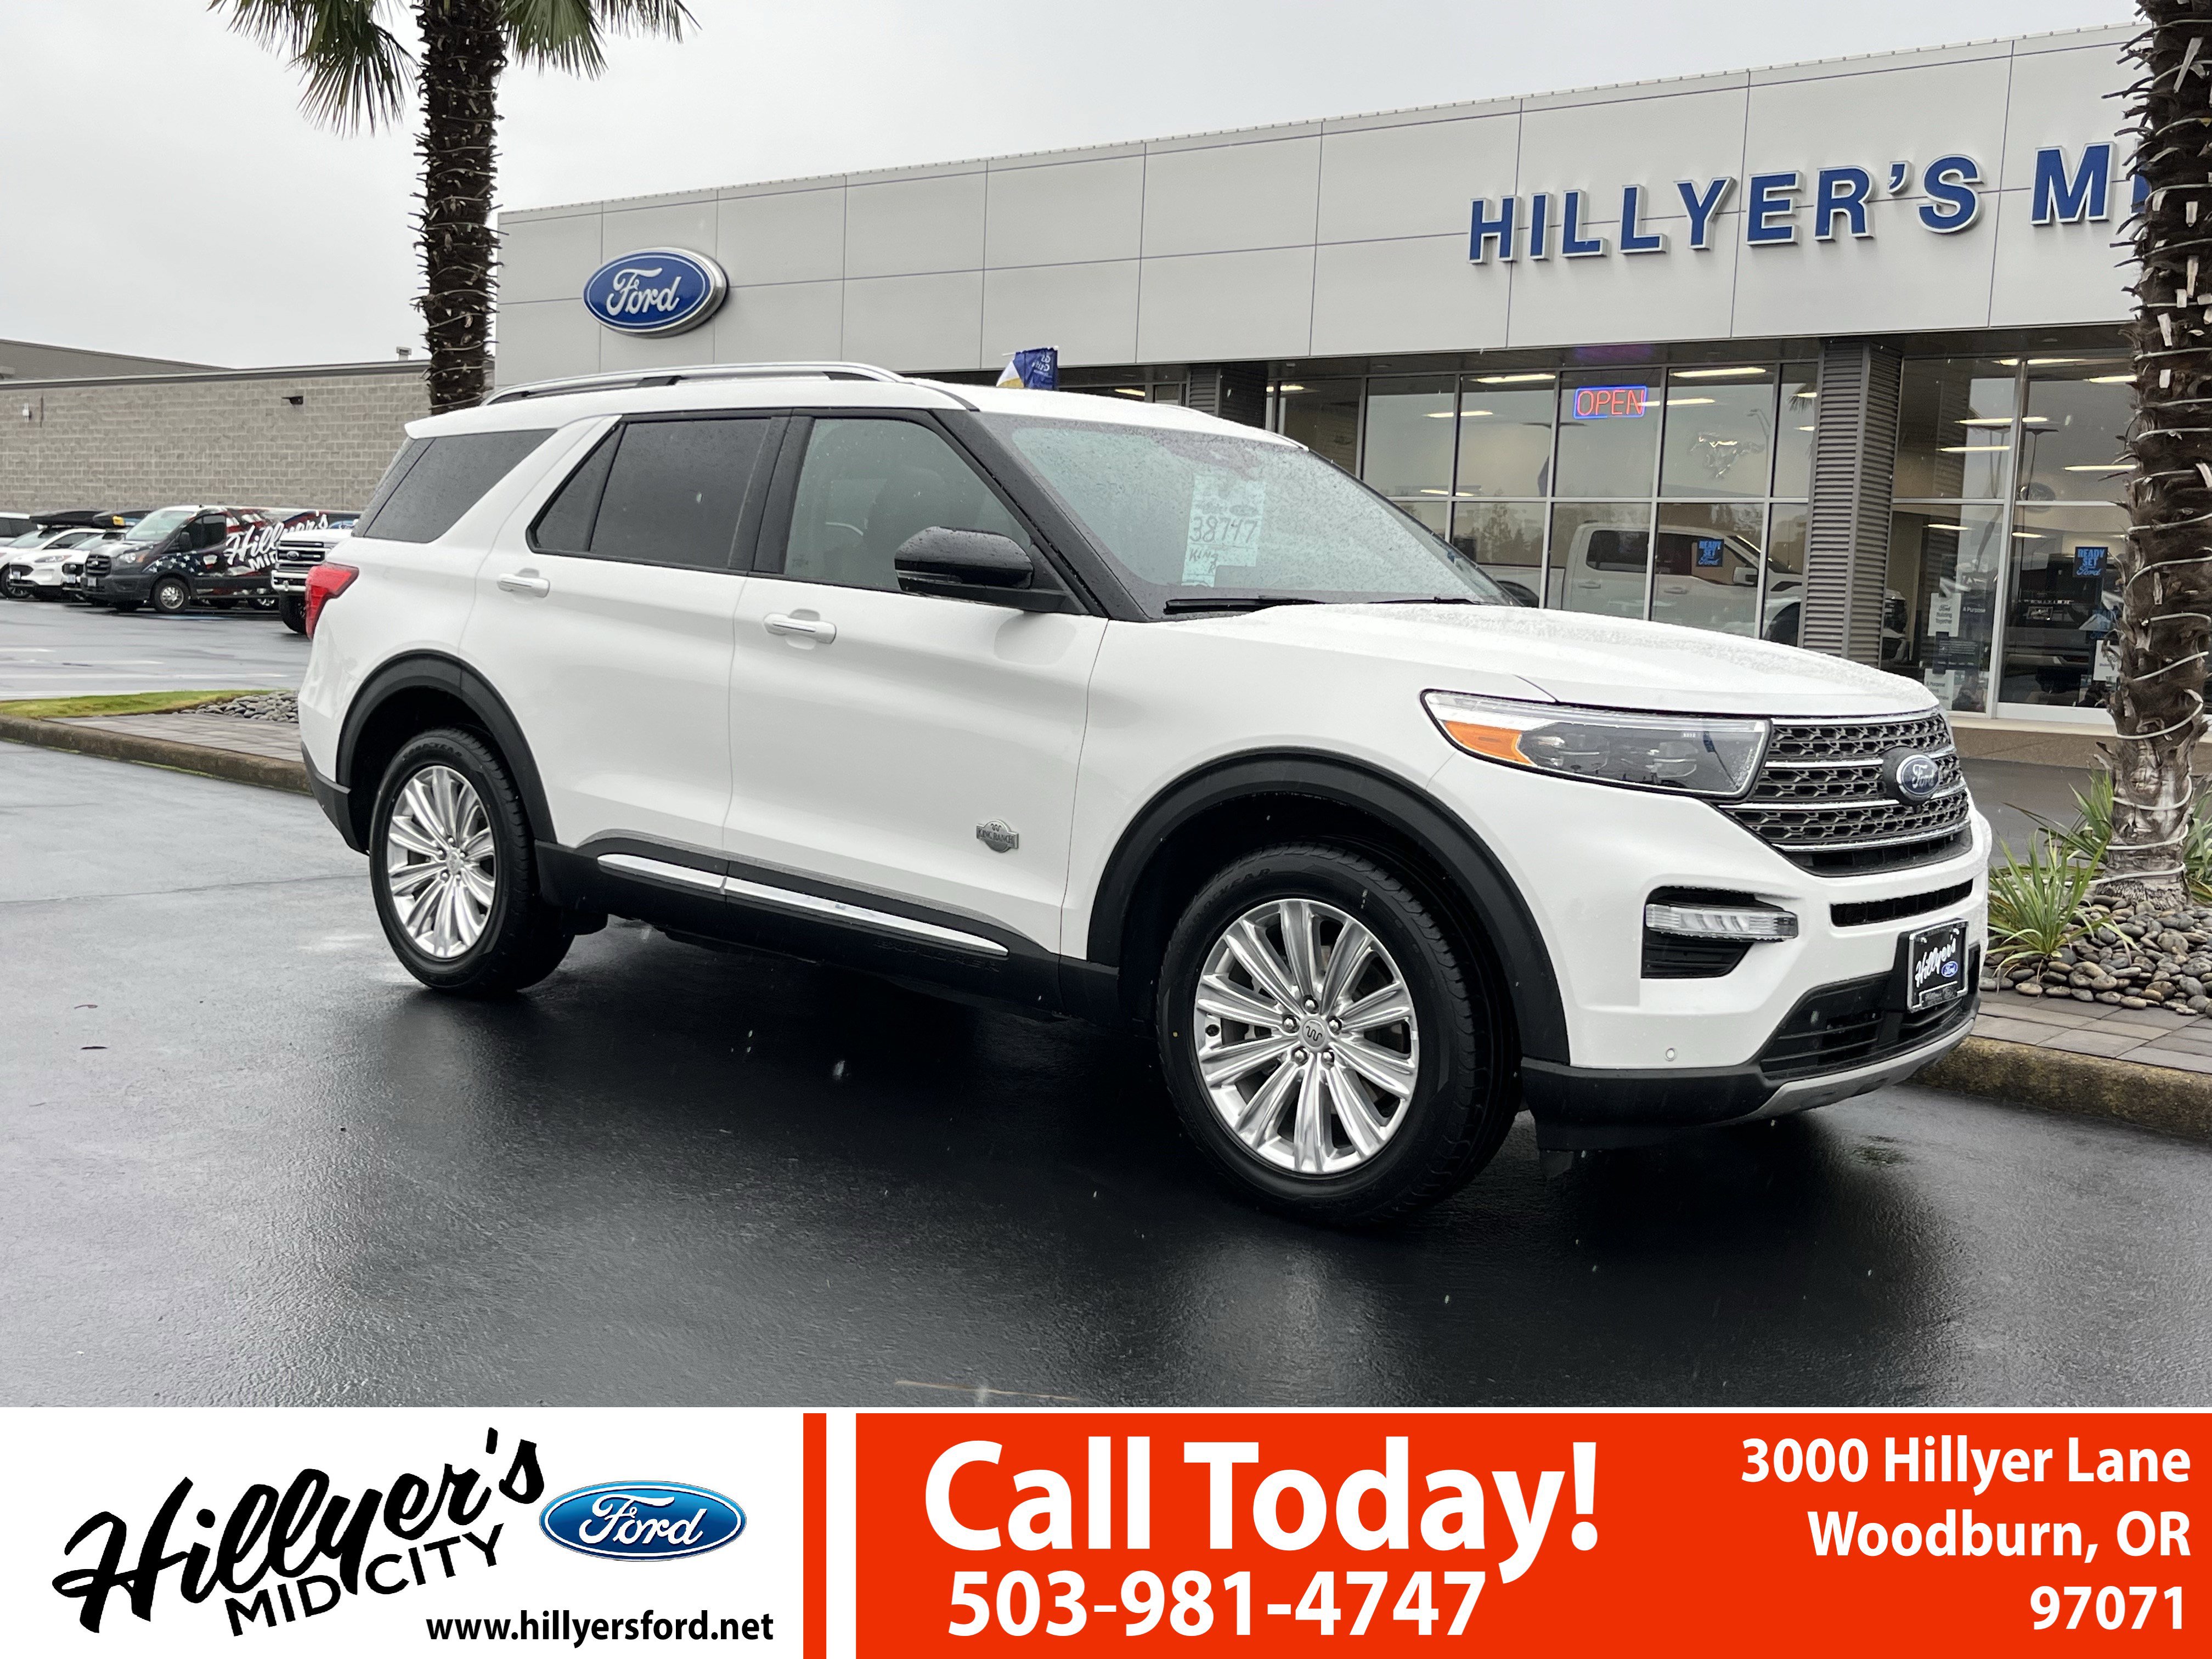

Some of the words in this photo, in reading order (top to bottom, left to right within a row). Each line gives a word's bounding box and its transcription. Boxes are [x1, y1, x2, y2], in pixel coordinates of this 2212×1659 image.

[1468, 154, 1984, 264] HILLYER'S
[606, 268, 681, 315] Ford
[1577, 390, 1644, 416] OPEN
[223, 510, 328, 565] Hiller's
[2078, 549, 2104, 558] READY
[2083, 558, 2097, 566] SET
[2076, 566, 2102, 576] Ford
[1912, 764, 1937, 789] Ford
